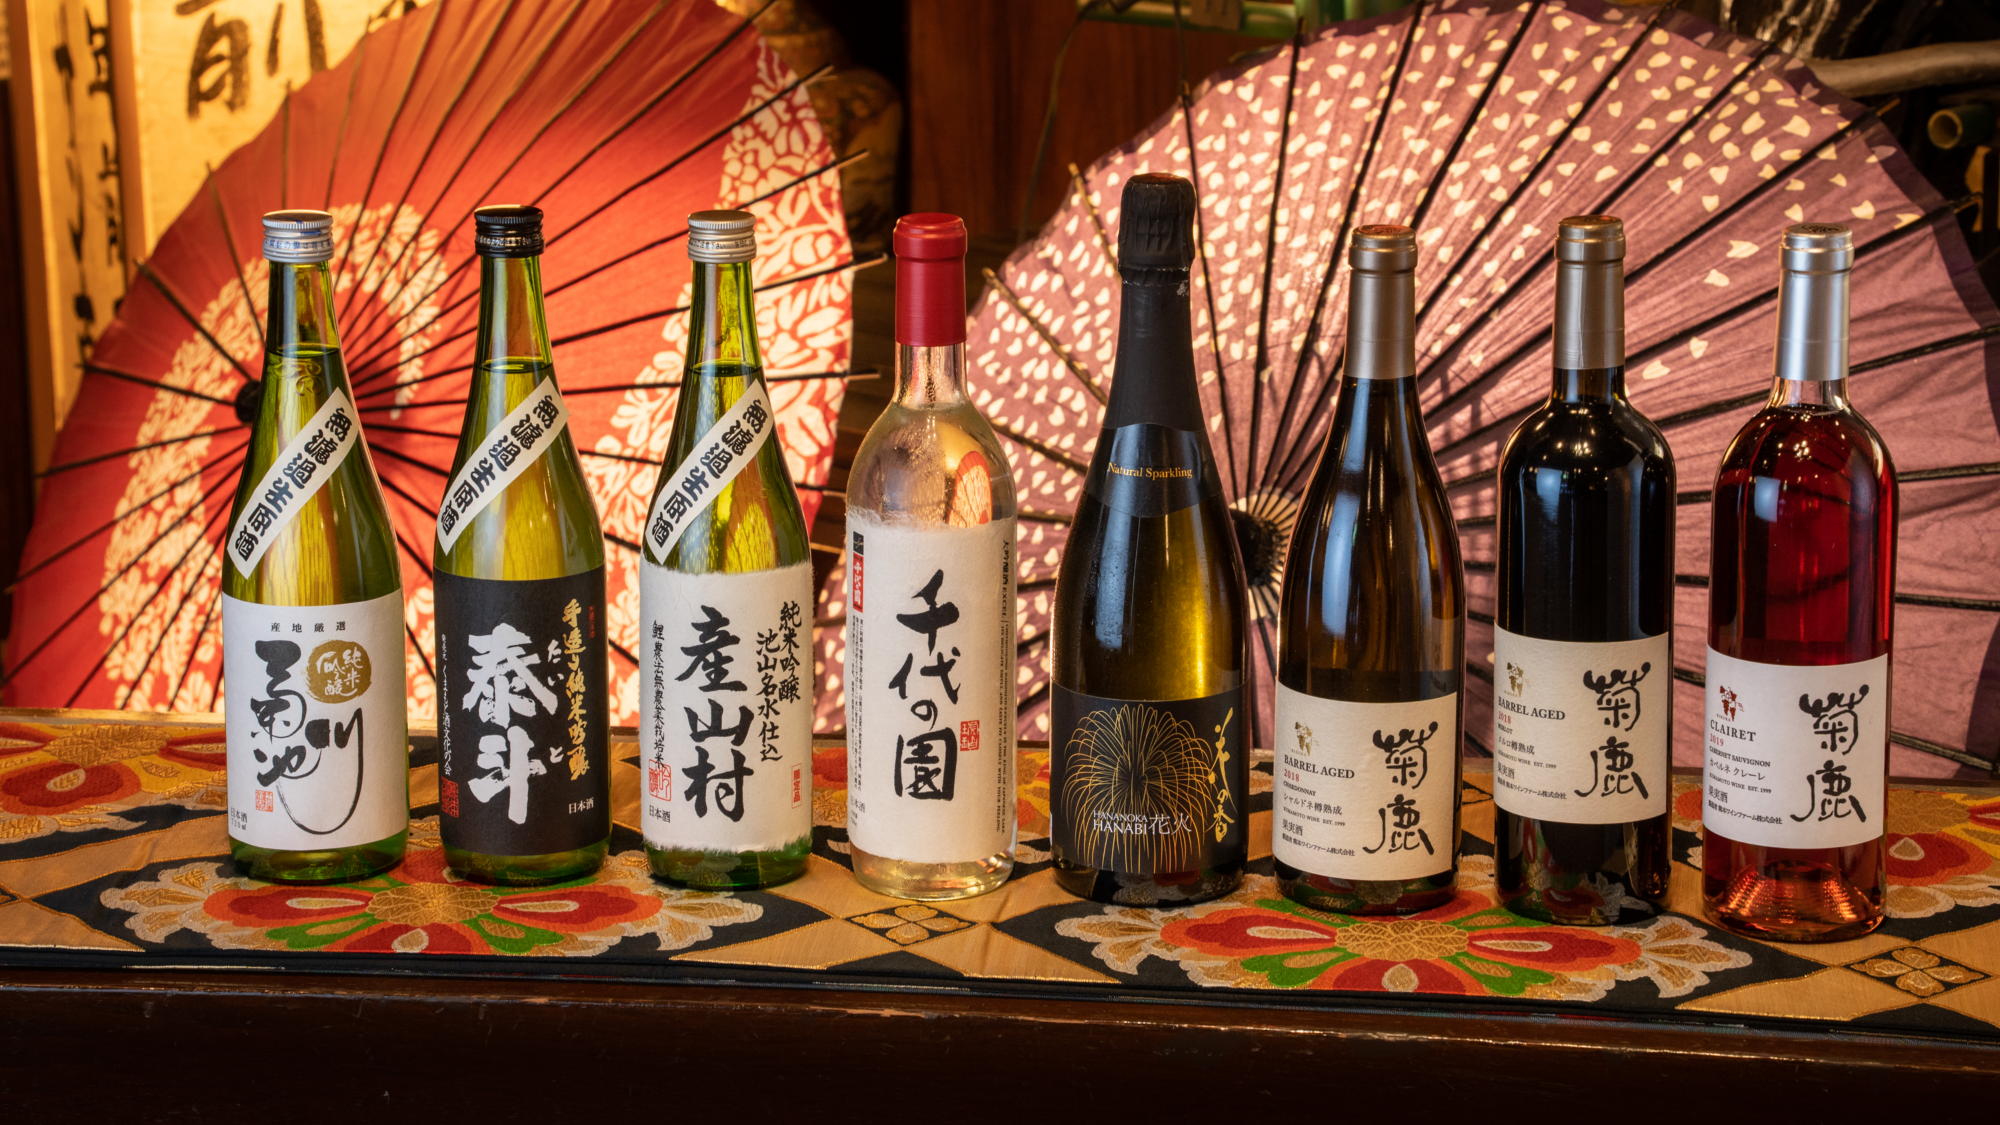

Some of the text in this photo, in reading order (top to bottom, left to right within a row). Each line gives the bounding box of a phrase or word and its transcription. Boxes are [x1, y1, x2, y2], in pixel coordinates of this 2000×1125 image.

[441, 394, 560, 537] 無濾過生原酒
[652, 399, 768, 549] 無濾過生原酒
[1107, 462, 1193, 480] Natural Sparkling
[235, 407, 353, 562] 無濾過生原酒
[270, 621, 346, 633] 産地厳選
[756, 628, 783, 762] 池山名水仕込
[888, 569, 960, 802] 千代の園
[674, 604, 754, 822] 産山村
[1498, 696, 1566, 720] BARREL AGED
[462, 622, 558, 824] 泰斗
[1574, 662, 1651, 800] 菊鹿
[1710, 719, 1757, 742] CLAIRET
[1732, 755, 1771, 767] SAUVIGNON
[1790, 684, 1869, 823] 菊鹿
[1284, 754, 1355, 779] BARREL AGED
[1733, 768, 1766, 780] クレーレ
[1363, 721, 1439, 855] 菊鹿
[568, 797, 594, 814] 日本酒
[649, 804, 671, 823] 日本酒
[1093, 809, 1148, 822] HANANOKA
[1093, 813, 1192, 836] HANABI 花火
